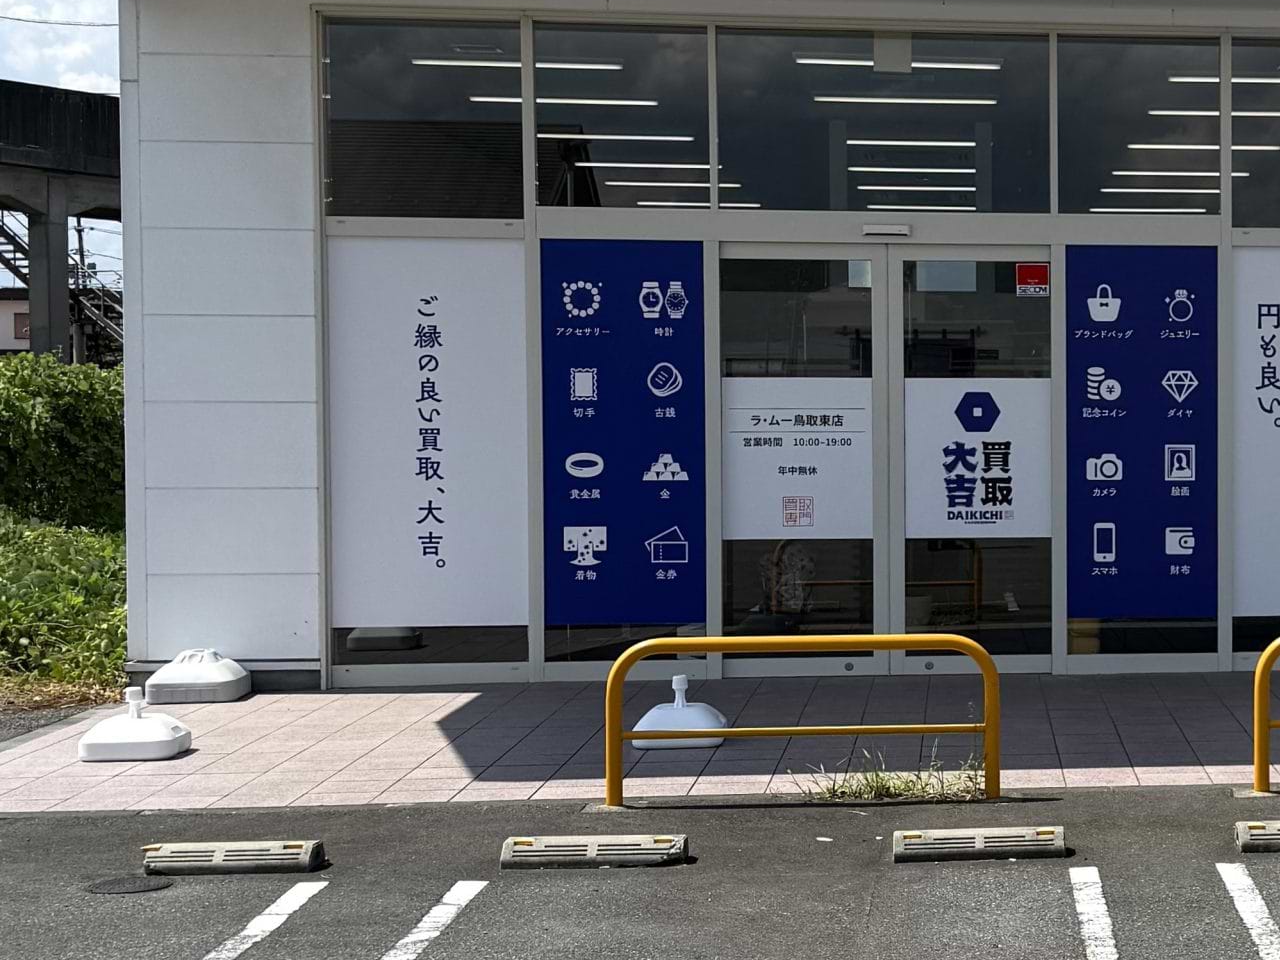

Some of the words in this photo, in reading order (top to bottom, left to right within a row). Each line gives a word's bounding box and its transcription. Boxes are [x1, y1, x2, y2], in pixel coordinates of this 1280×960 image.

[556, 327, 610, 336] アクセサリー
[654, 326, 674, 337] 時計
[1075, 329, 1134, 339] ブランドバッグ
[1160, 329, 1200, 339] ジュエリー
[573, 407, 596, 418] 切手
[654, 406, 676, 418] 古銭
[1082, 407, 1127, 418] 記念コイン
[1167, 408, 1193, 418] ダイヤ
[750, 414, 844, 427] ラ・ムー鳥取東店
[413, 295, 446, 569] ご縁の良い買取、大吉。
[743, 436, 783, 447] 営業時間
[793, 437, 852, 447] 10:00-19:00
[777, 465, 818, 476] 年中無休
[942, 441, 979, 508] 大吉
[980, 440, 1013, 506] 買取
[569, 488, 601, 500] 貴金属
[659, 488, 671, 499] 金
[1092, 487, 1117, 497] カメラ
[1170, 486, 1190, 497] 絵画
[946, 510, 1003, 520] DAIKICHI
[574, 569, 597, 581] 着物
[655, 568, 677, 580] 金券
[1091, 566, 1118, 576] スマホ
[1170, 564, 1191, 575] 財布
